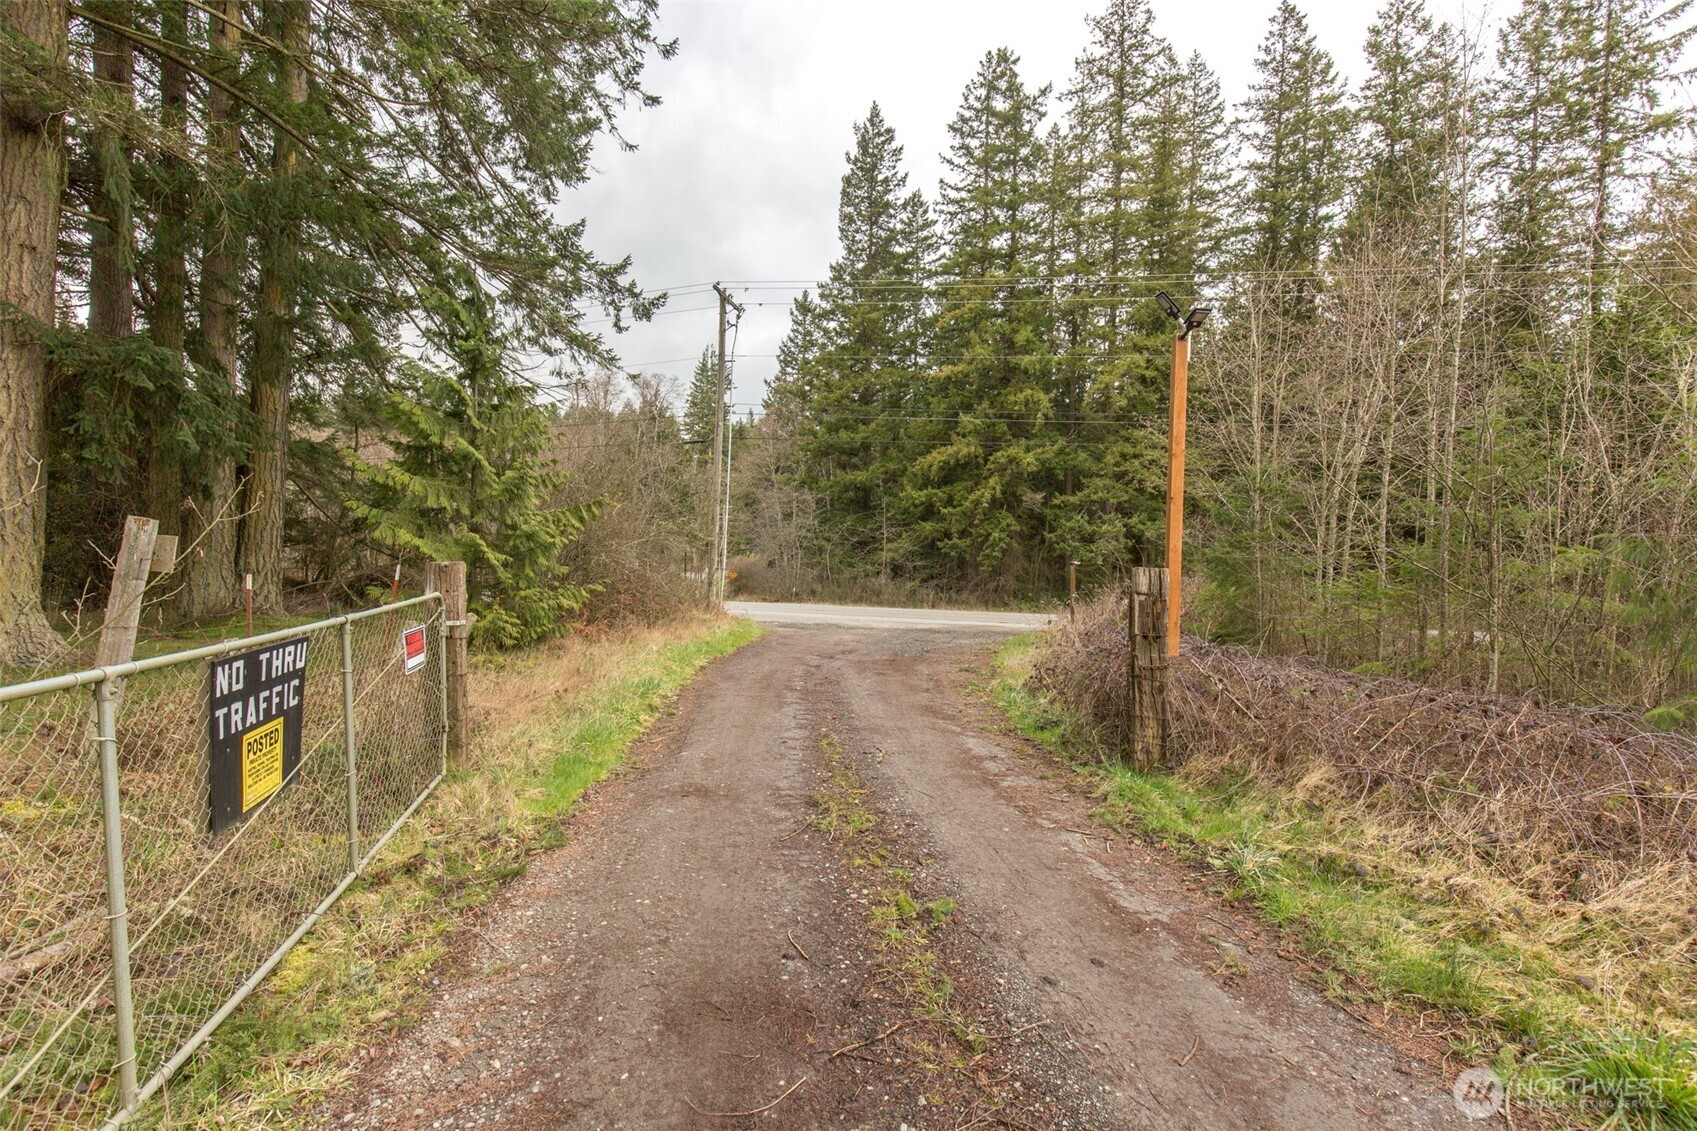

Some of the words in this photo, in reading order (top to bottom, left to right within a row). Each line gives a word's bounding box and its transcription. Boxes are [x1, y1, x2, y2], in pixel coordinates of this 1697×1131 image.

[216, 659, 245, 698] NO
[259, 641, 307, 682] THRU
[215, 678, 300, 740] TRAFFIC
[247, 727, 280, 760] POSTED
